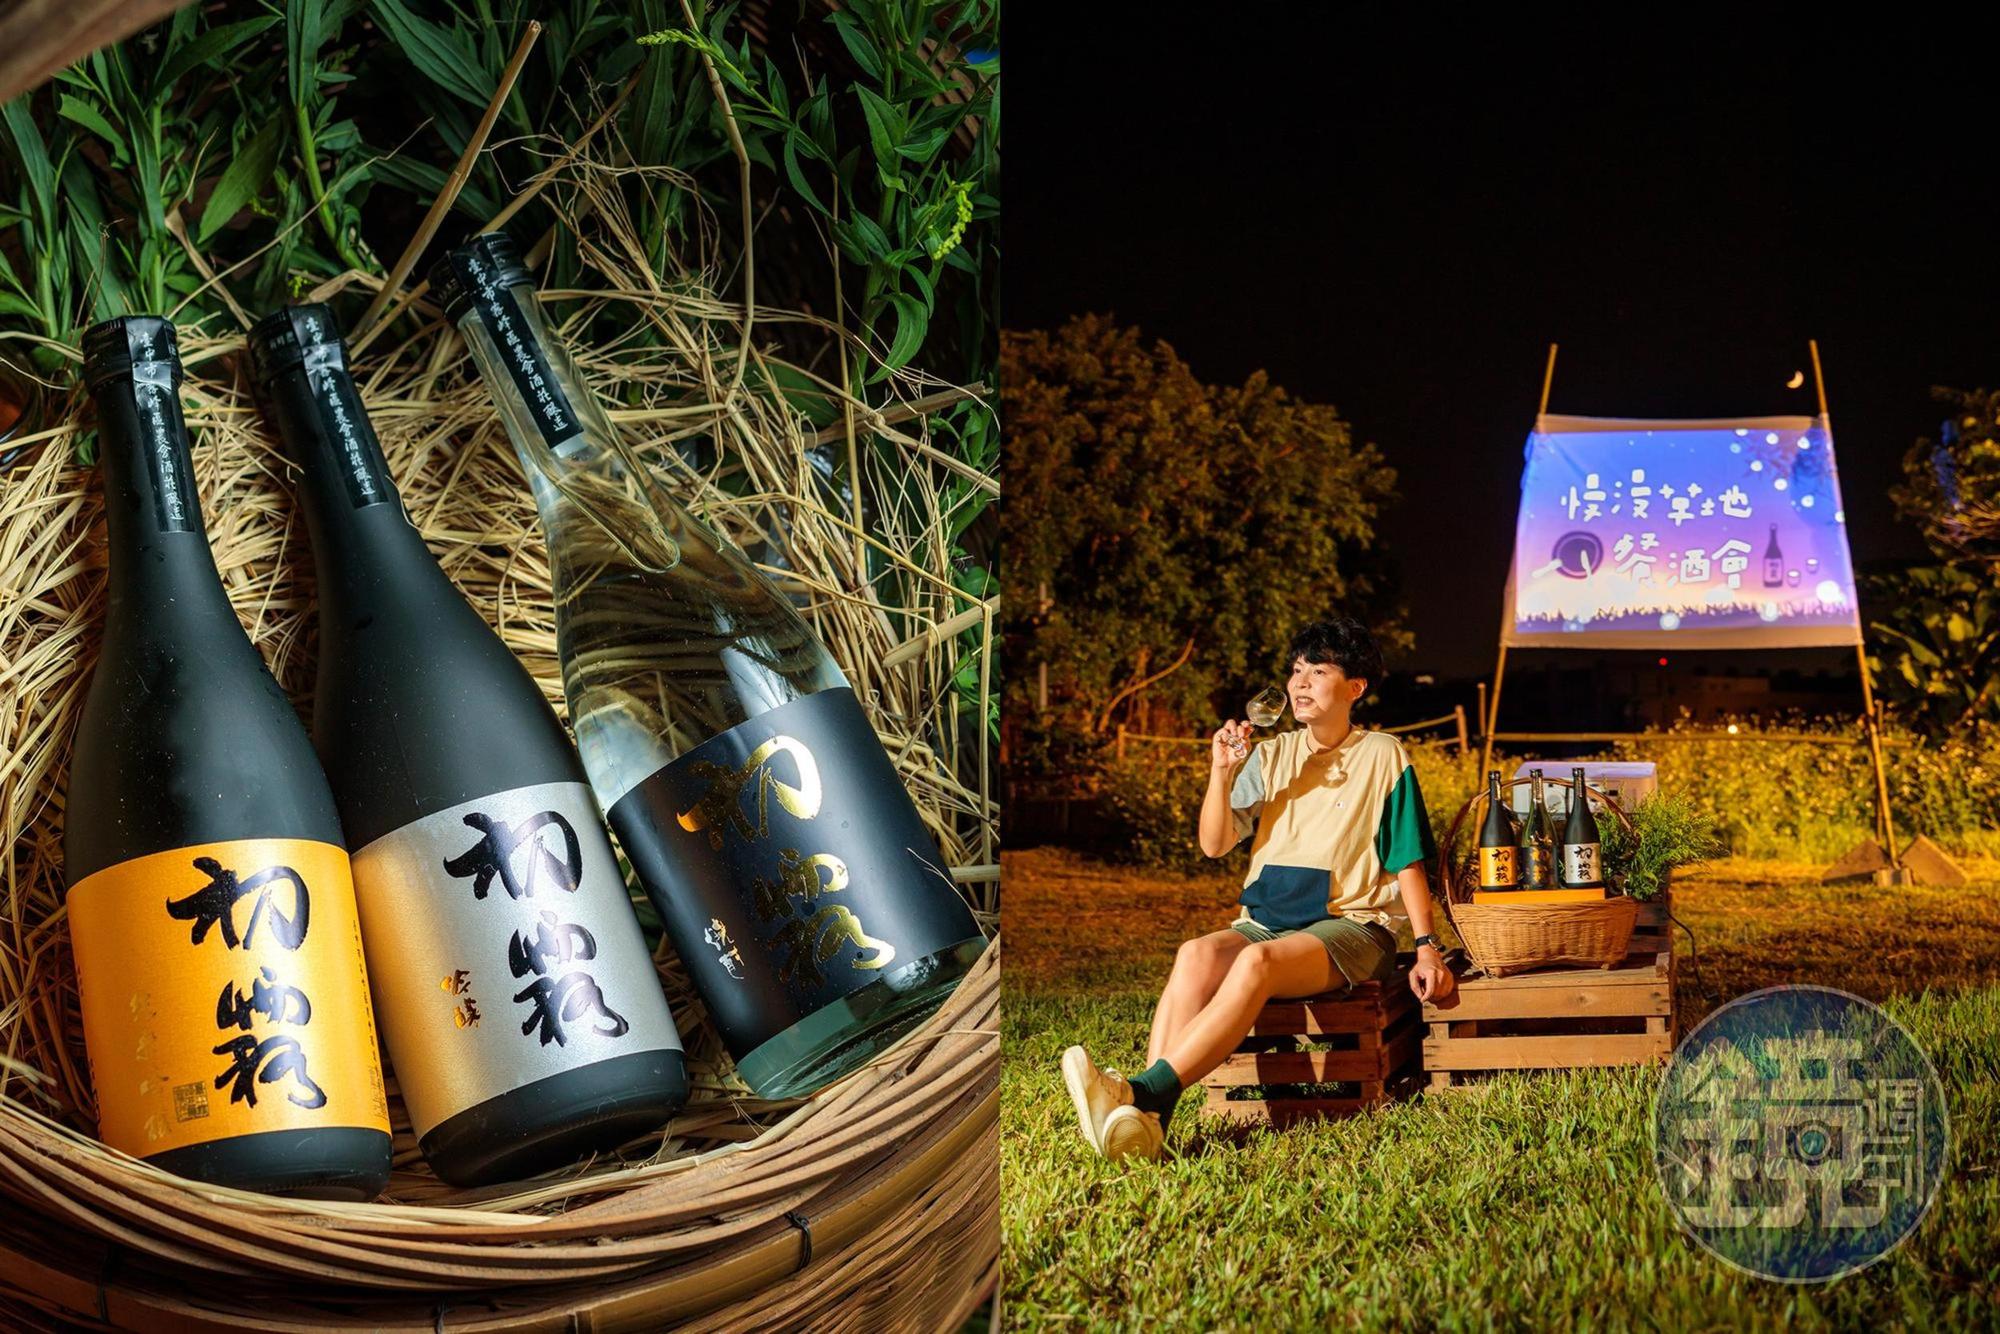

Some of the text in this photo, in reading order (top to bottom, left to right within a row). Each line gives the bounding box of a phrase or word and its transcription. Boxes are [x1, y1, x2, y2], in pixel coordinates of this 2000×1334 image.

[1560, 469, 1752, 526] 慢漫草地
[1613, 533, 1752, 589] 餐酒會
